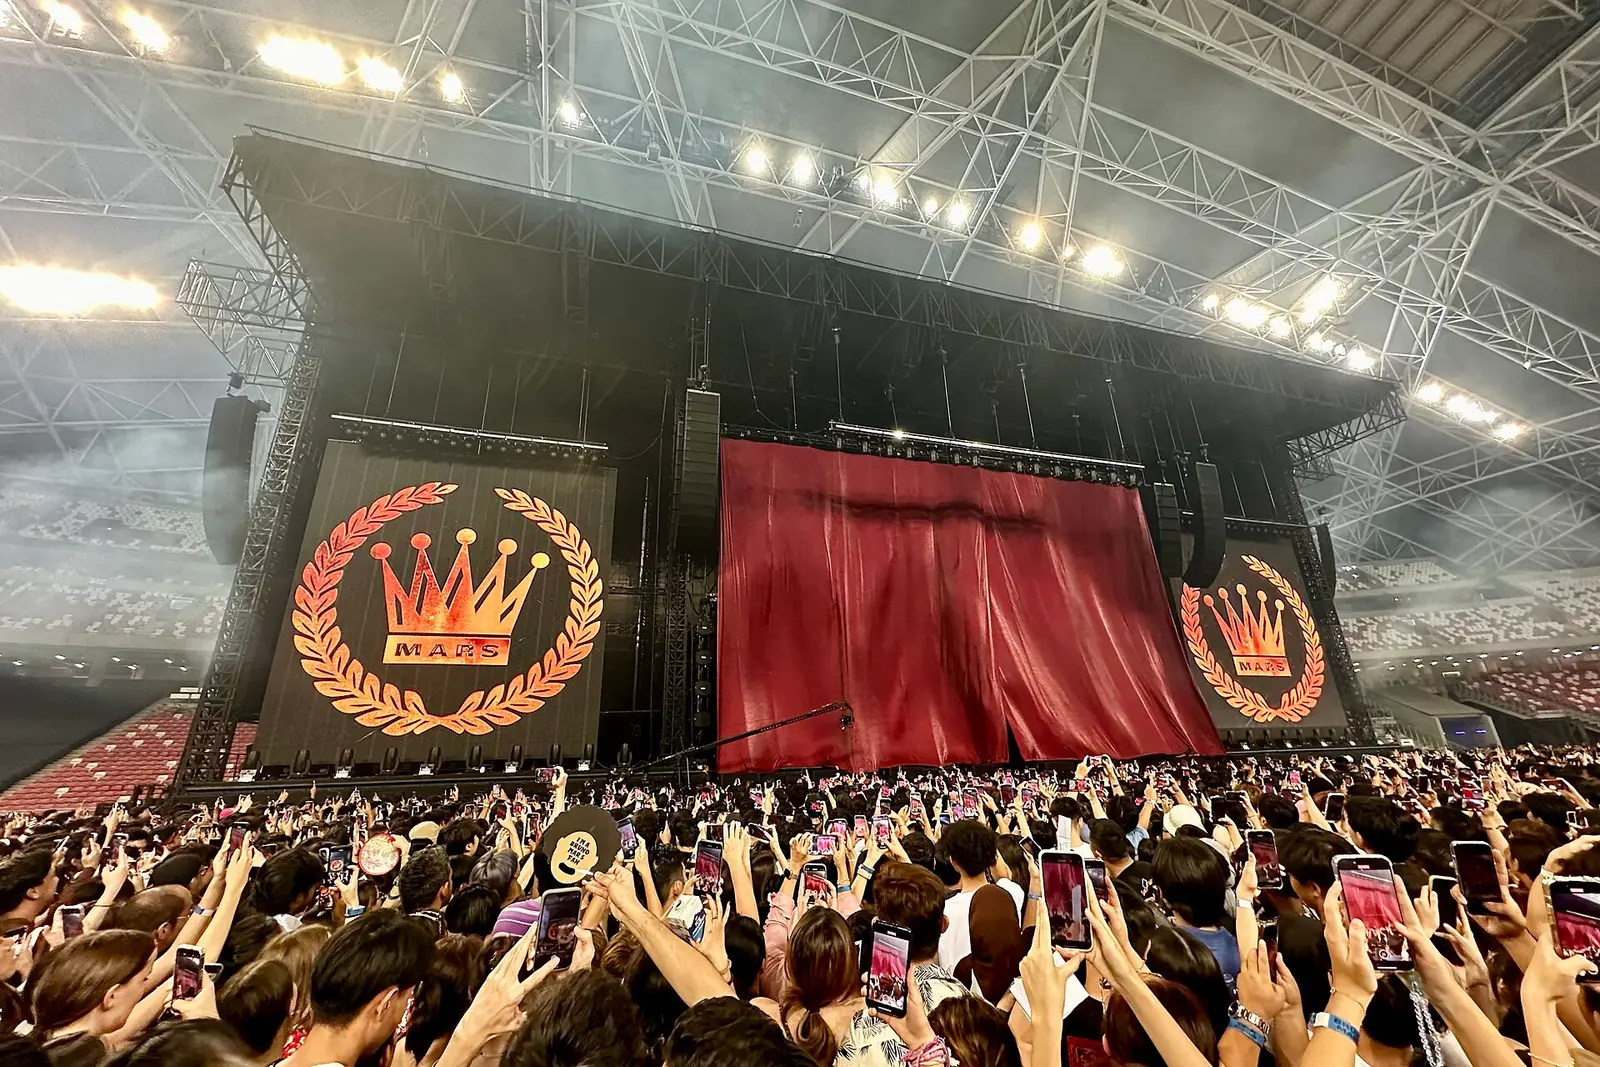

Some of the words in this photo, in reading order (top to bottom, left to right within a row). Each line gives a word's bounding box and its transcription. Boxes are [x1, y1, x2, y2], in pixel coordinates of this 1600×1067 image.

[394, 642, 499, 658] MARS
[1238, 661, 1285, 672] MARS
[567, 847, 585, 860] MARS
[569, 841, 590, 855] BRUNO
[567, 854, 581, 865] FAN
